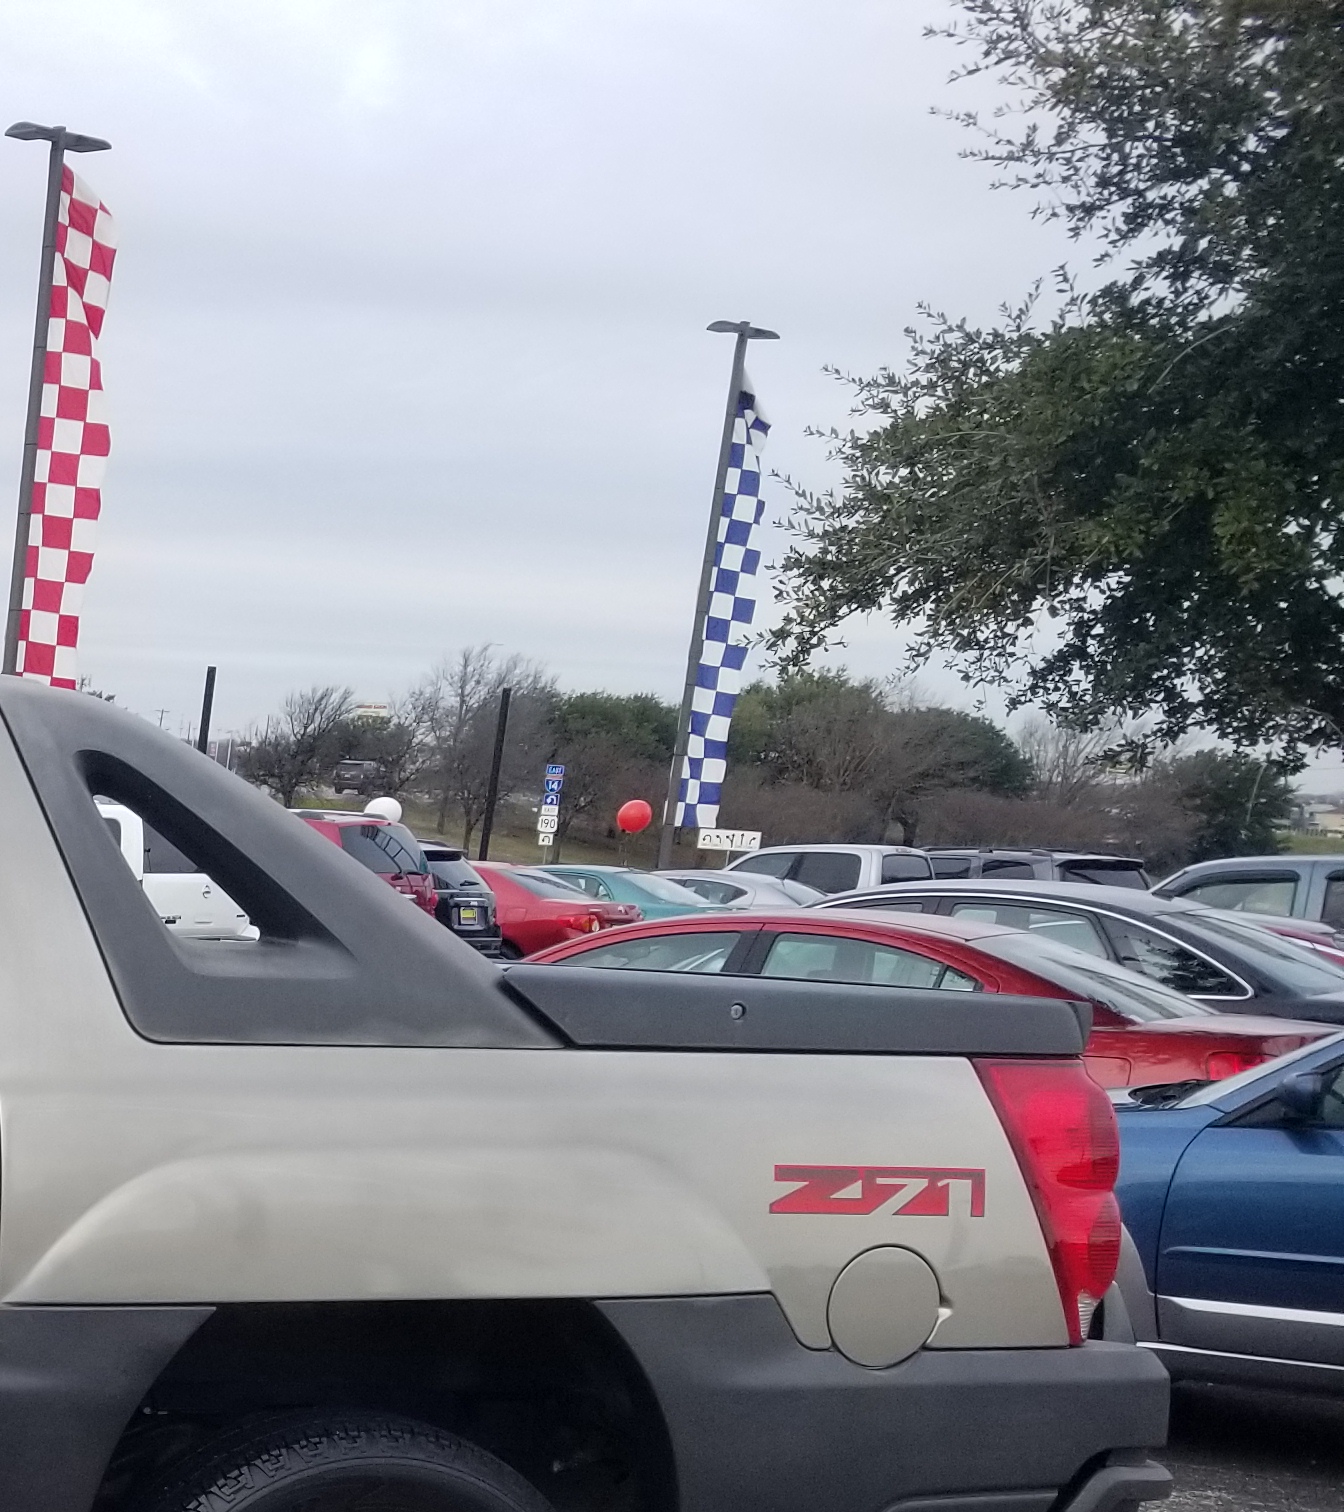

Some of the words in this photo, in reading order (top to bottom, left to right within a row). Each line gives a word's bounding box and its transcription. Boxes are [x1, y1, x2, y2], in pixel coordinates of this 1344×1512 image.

[548, 780, 558, 790] 14
[540, 818, 556, 829] 190
[769, 1164, 986, 1217] Z71
